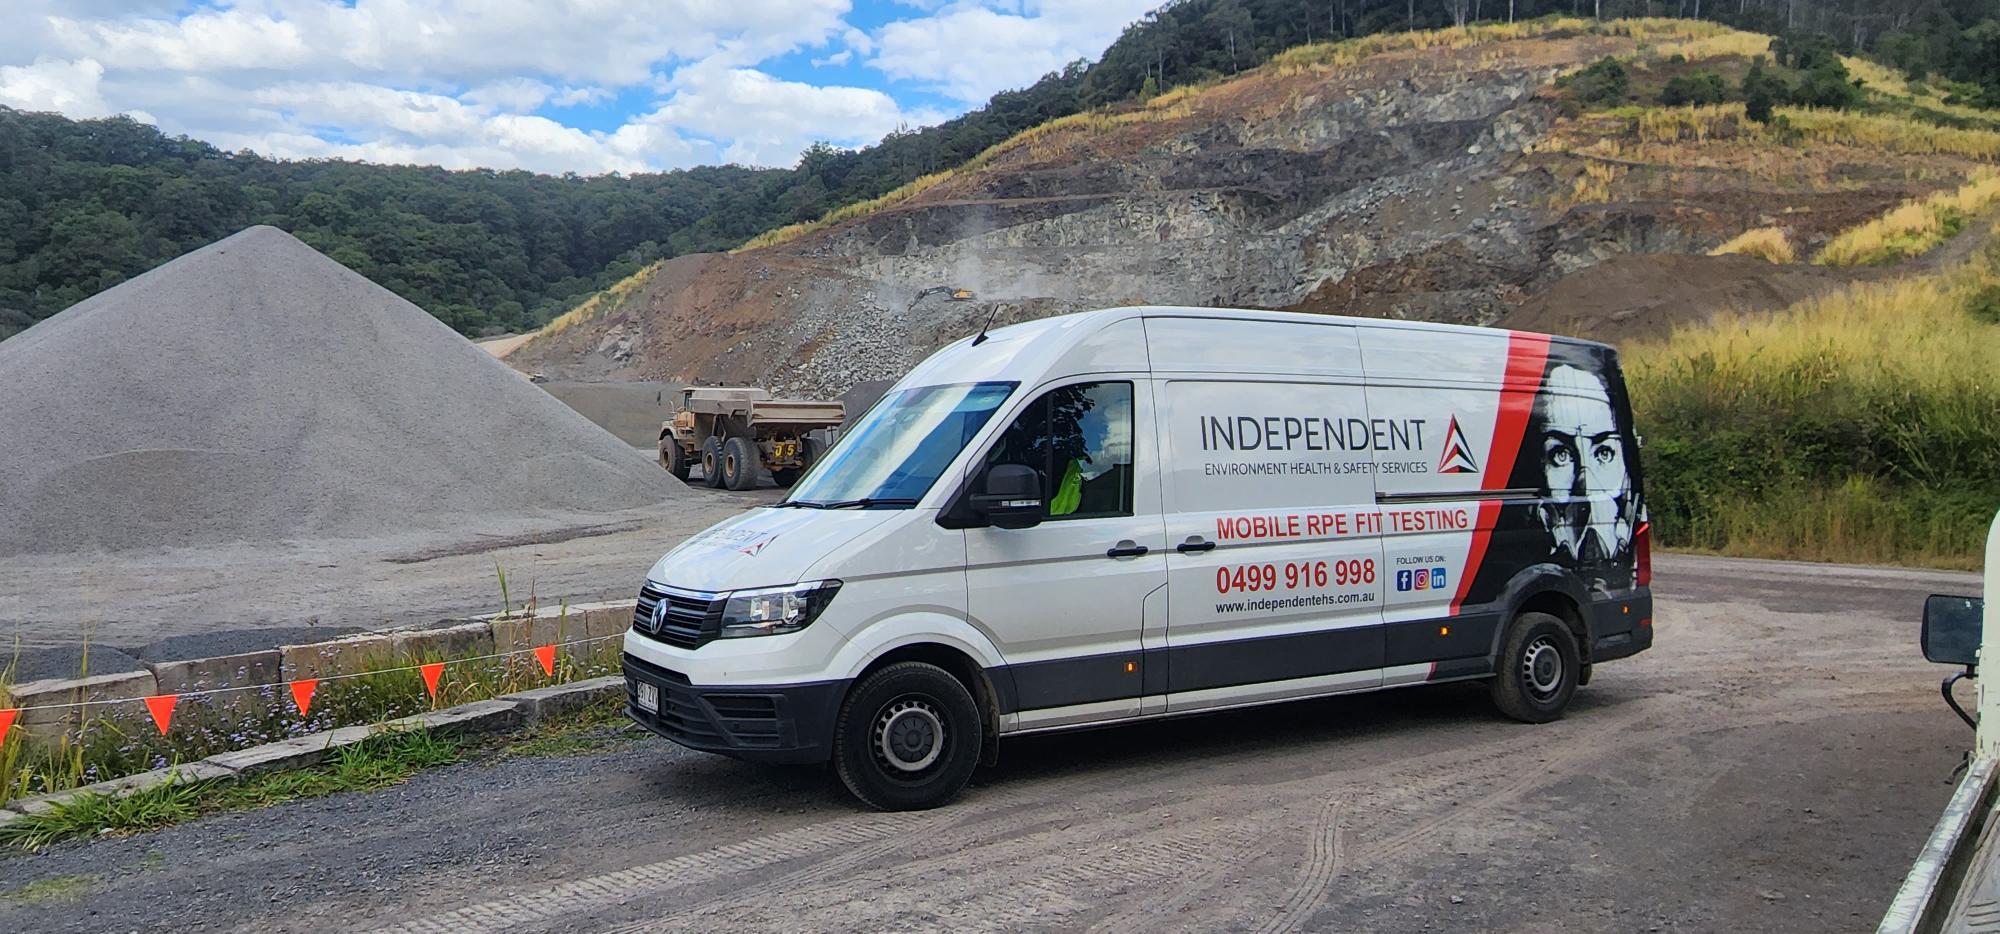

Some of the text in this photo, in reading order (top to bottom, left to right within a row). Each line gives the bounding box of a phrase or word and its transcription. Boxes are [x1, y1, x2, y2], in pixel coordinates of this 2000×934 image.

[1200, 416, 1426, 451] INDEPENDENT
[1205, 462, 1428, 476] ENVIRONMENT HEALTH & SAFETY SERVICES
[1217, 509, 1468, 540] MOBILE RPE FIT TESTING
[1396, 556, 1424, 565] FOLLOW
[1424, 555, 1434, 563] US
[1216, 558, 1375, 594] 0499 916 998
[1215, 591, 1376, 614] www.independentehs.com.au
